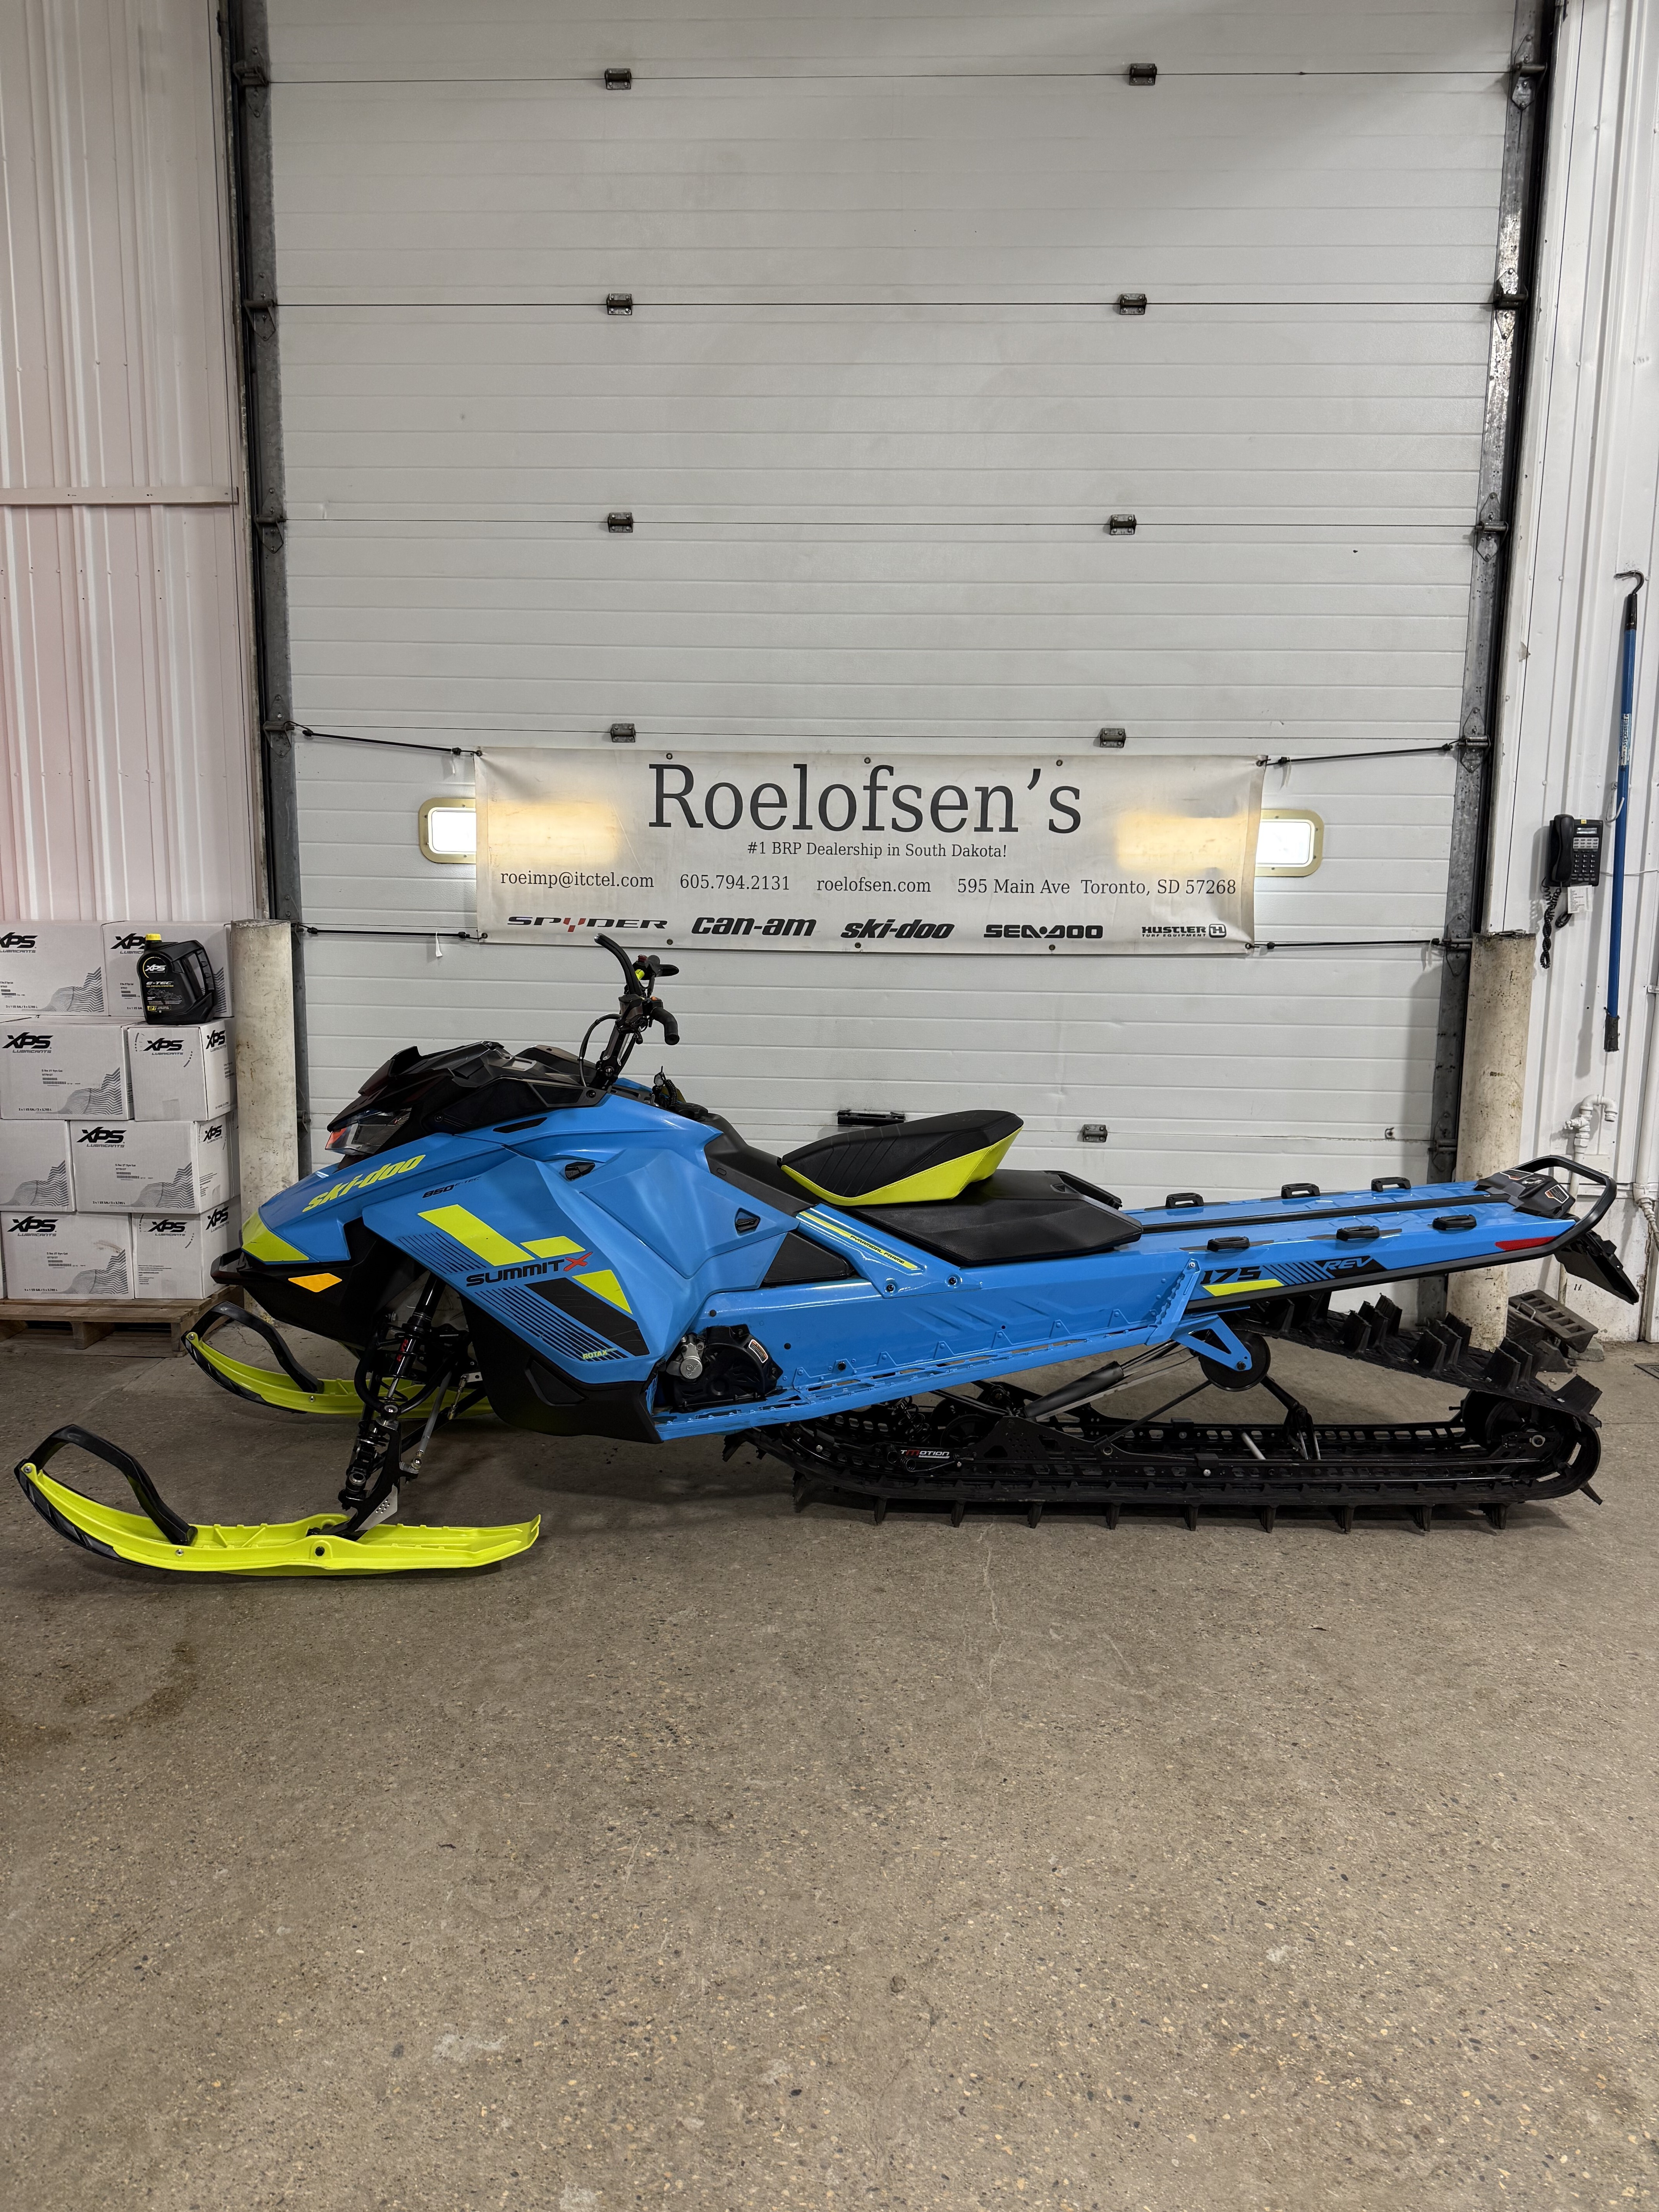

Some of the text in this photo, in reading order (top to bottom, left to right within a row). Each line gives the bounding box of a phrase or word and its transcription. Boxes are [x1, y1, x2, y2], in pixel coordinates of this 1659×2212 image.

[748, 842, 1006, 859] #1 BRP Dealership in South Dakota!
[501, 870, 654, 888] roeimp@itctel.com
[680, 874, 789, 890] 605.794.2131
[817, 876, 931, 892] roelofsen.com
[958, 879, 1236, 896] 595 Main Ave Toronto, SD 57268
[507, 917, 668, 933] SPYDER
[692, 917, 816, 936] can-am
[841, 919, 955, 938] ski-doo
[2, 1032, 53, 1049] XPS
[143, 1038, 184, 1051] XPS
[206, 1030, 226, 1049] XPS
[77, 1127, 127, 1144] XPS
[203, 1125, 222, 1142] XPS
[302, 1154, 426, 1212] ski-doo
[422, 1184, 455, 1198] 850
[7, 1216, 59, 1232] XPS
[148, 1219, 188, 1233] XPS
[206, 1206, 229, 1230] XPS
[466, 1252, 593, 1286] SUMMIT X
[1321, 1256, 1374, 1272] REV
[1200, 1266, 1263, 1285] 175
[582, 1349, 608, 1360] ROTAX
